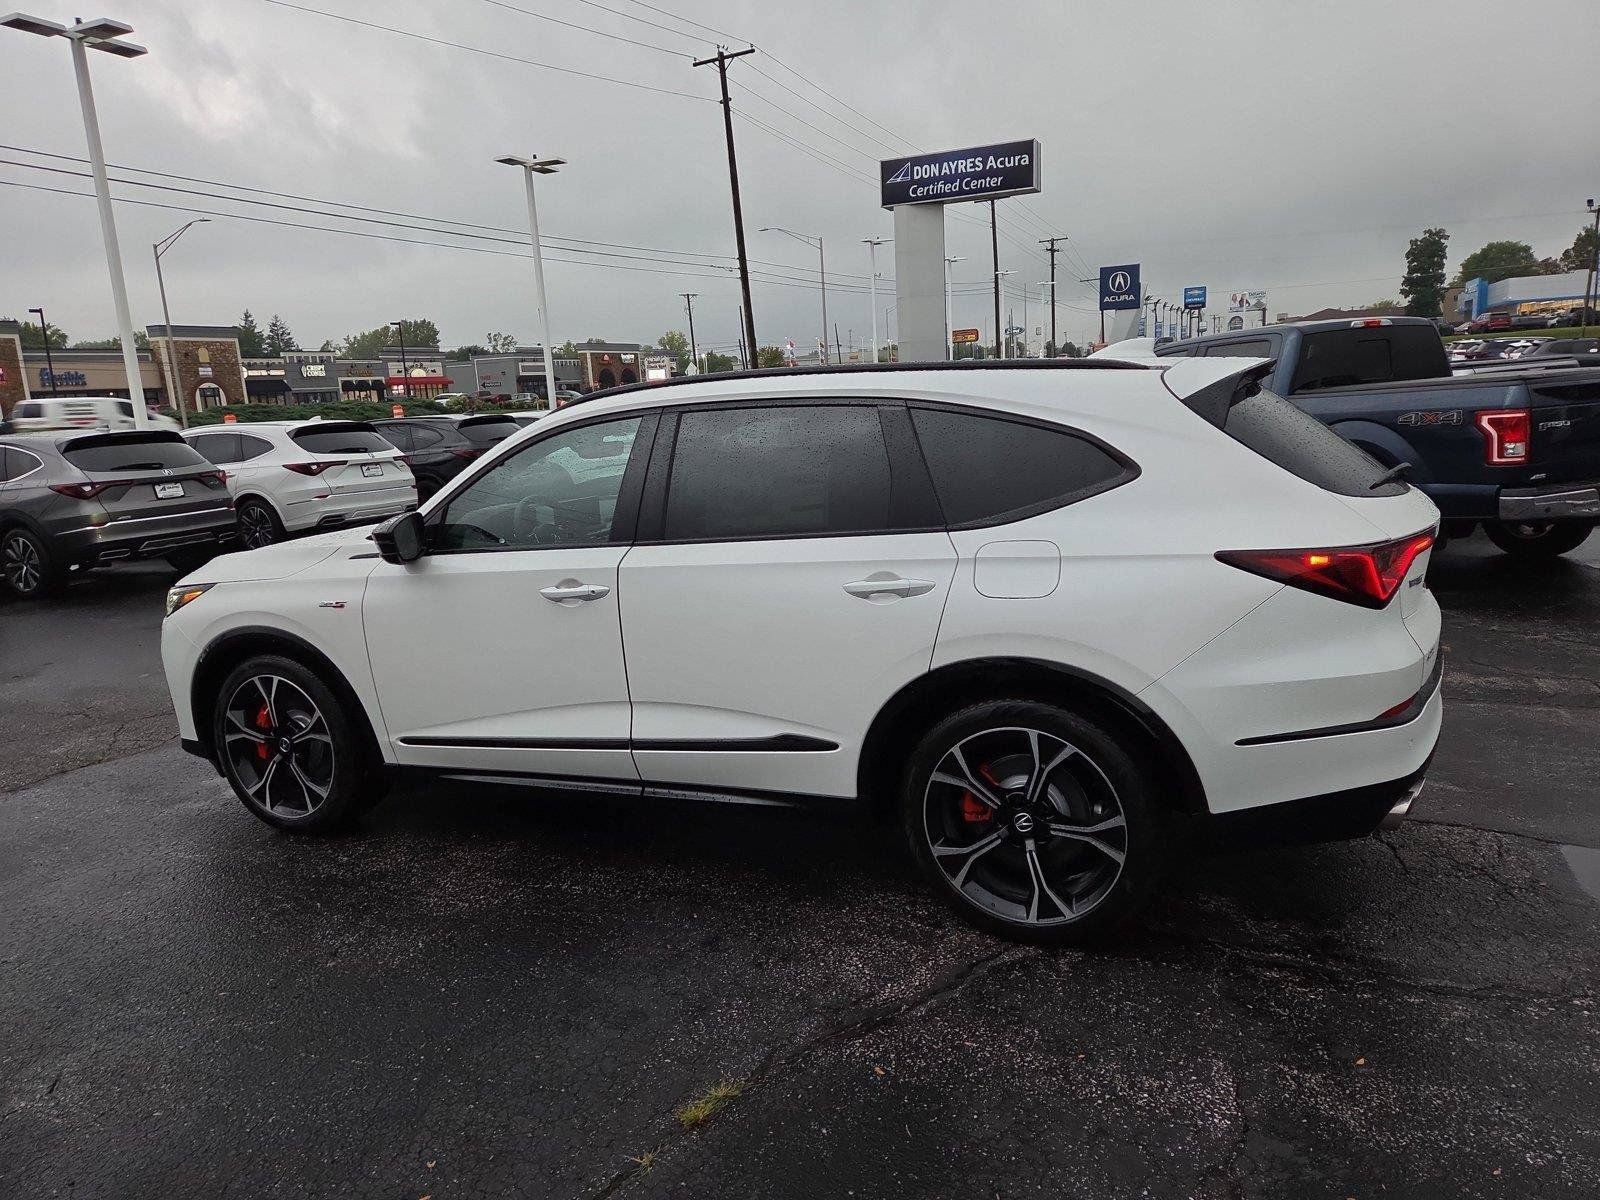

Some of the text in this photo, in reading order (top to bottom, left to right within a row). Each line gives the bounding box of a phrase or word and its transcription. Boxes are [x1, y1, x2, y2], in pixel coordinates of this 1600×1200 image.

[913, 153, 1030, 180] DON AYRES Acura
[909, 175, 1003, 198] Certified Center
[1103, 294, 1136, 303] ACURA
